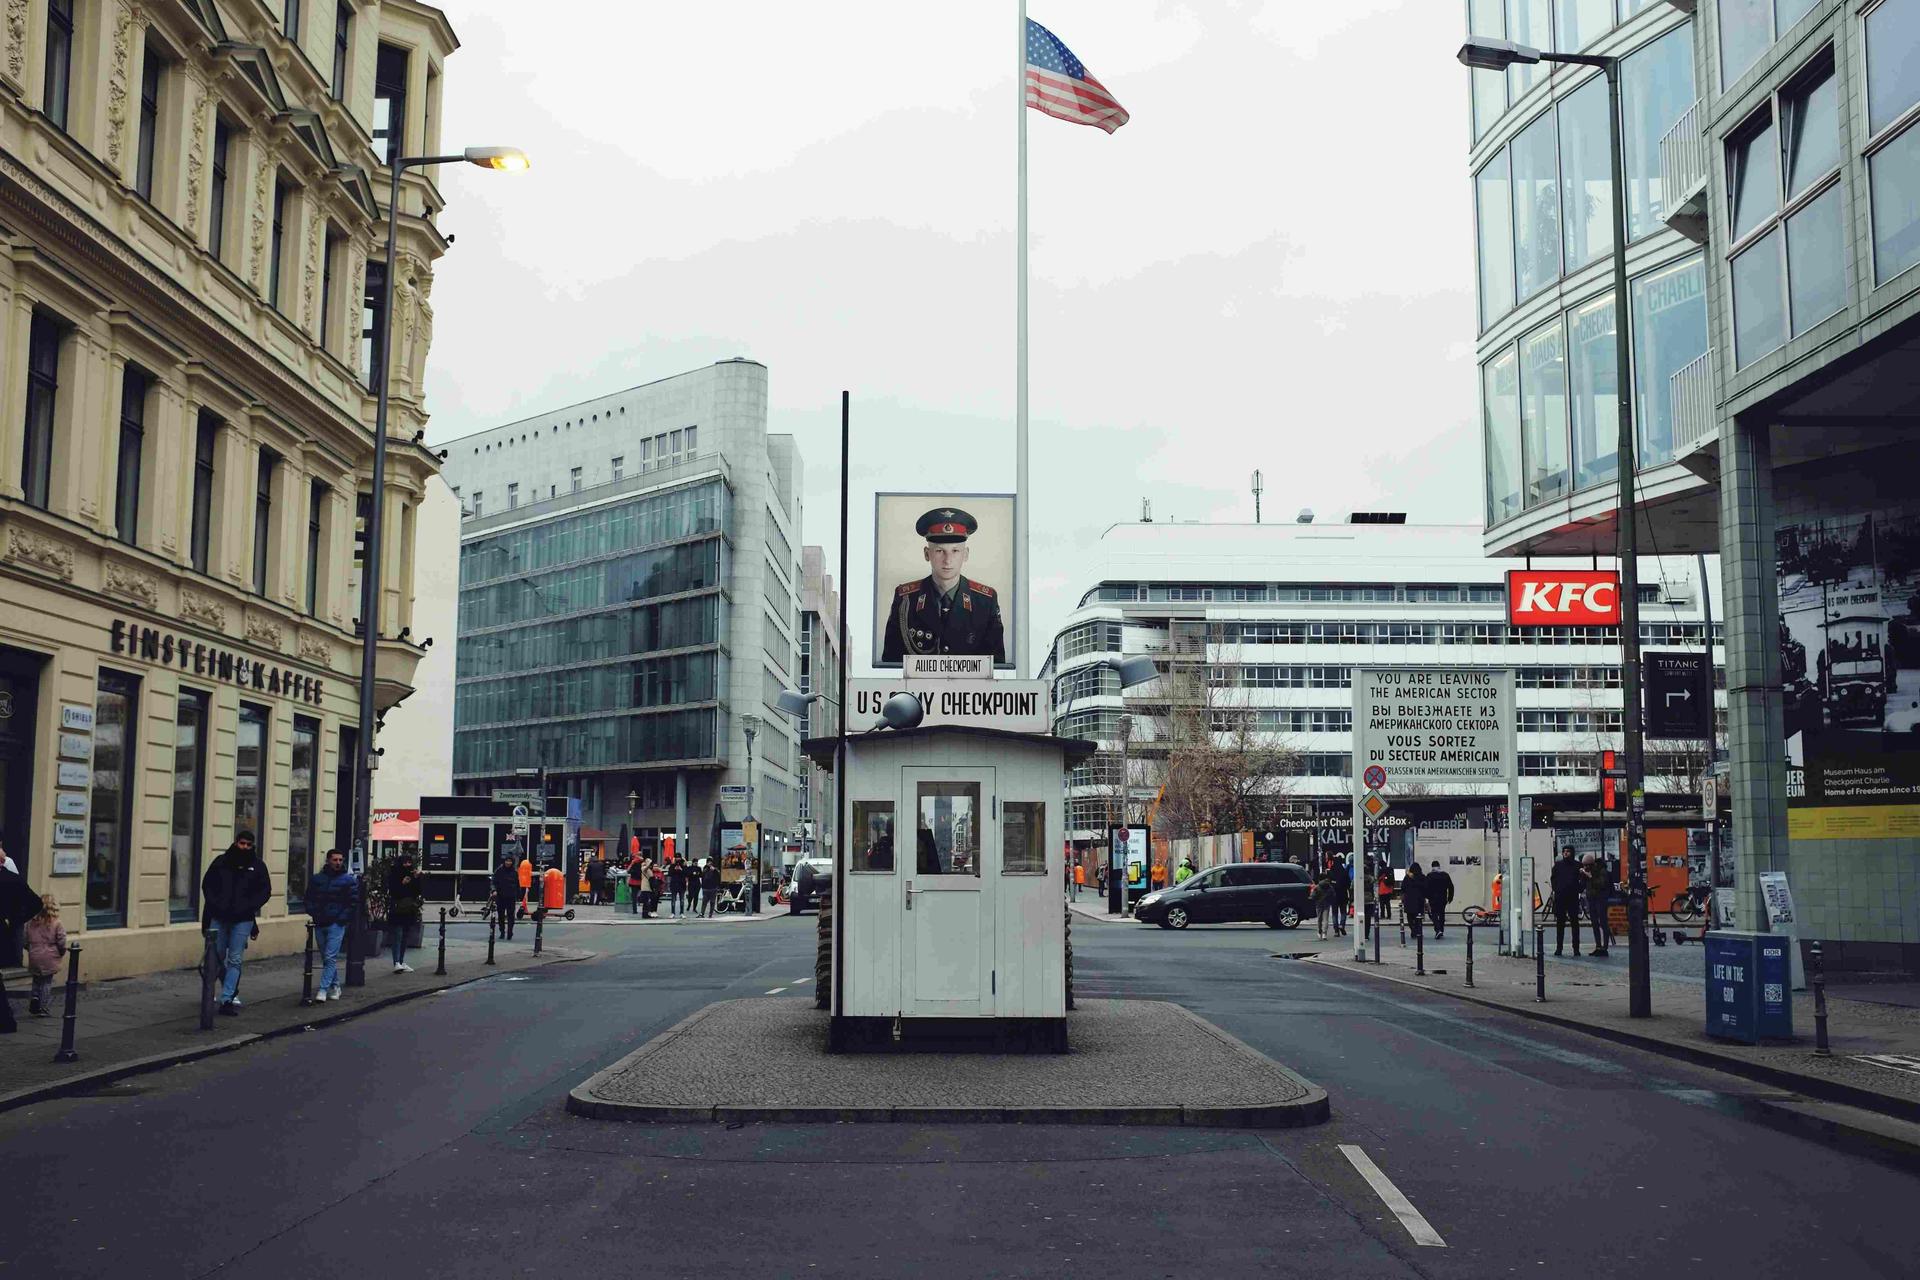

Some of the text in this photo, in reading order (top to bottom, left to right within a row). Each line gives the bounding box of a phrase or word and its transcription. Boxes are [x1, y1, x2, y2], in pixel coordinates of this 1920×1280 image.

[1516, 582, 1614, 612] KFC
[111, 618, 323, 704] EINSTEIN KAFFEE
[915, 660, 982, 672] ALLIED CHECKPOINT
[1658, 660, 1699, 668] TITANIC
[1376, 673, 1490, 685] YOU ARE LEAVING
[1370, 687, 1497, 699] THE AMERICAN SECTOR
[941, 692, 1038, 716] CHECKPOINT
[1372, 706, 1496, 716] ВЫ ВЫЕЗЖАЕТЕ ИЗ
[1370, 719, 1499, 730] АМЕРИКАНСКОГО СЕКТОРА
[1387, 736, 1476, 747] VOUS SORTEZ
[1370, 750, 1384, 761] DU
[1389, 750, 1436, 761] SECTEUR
[1414, 767, 1426, 776] DEN
[1427, 767, 1477, 776] AMERIKANISCHEN
[1478, 767, 1499, 776] SEKTOR
[1856, 786, 1888, 794] Freedom
[1714, 964, 1744, 982] LIFE IN THE
